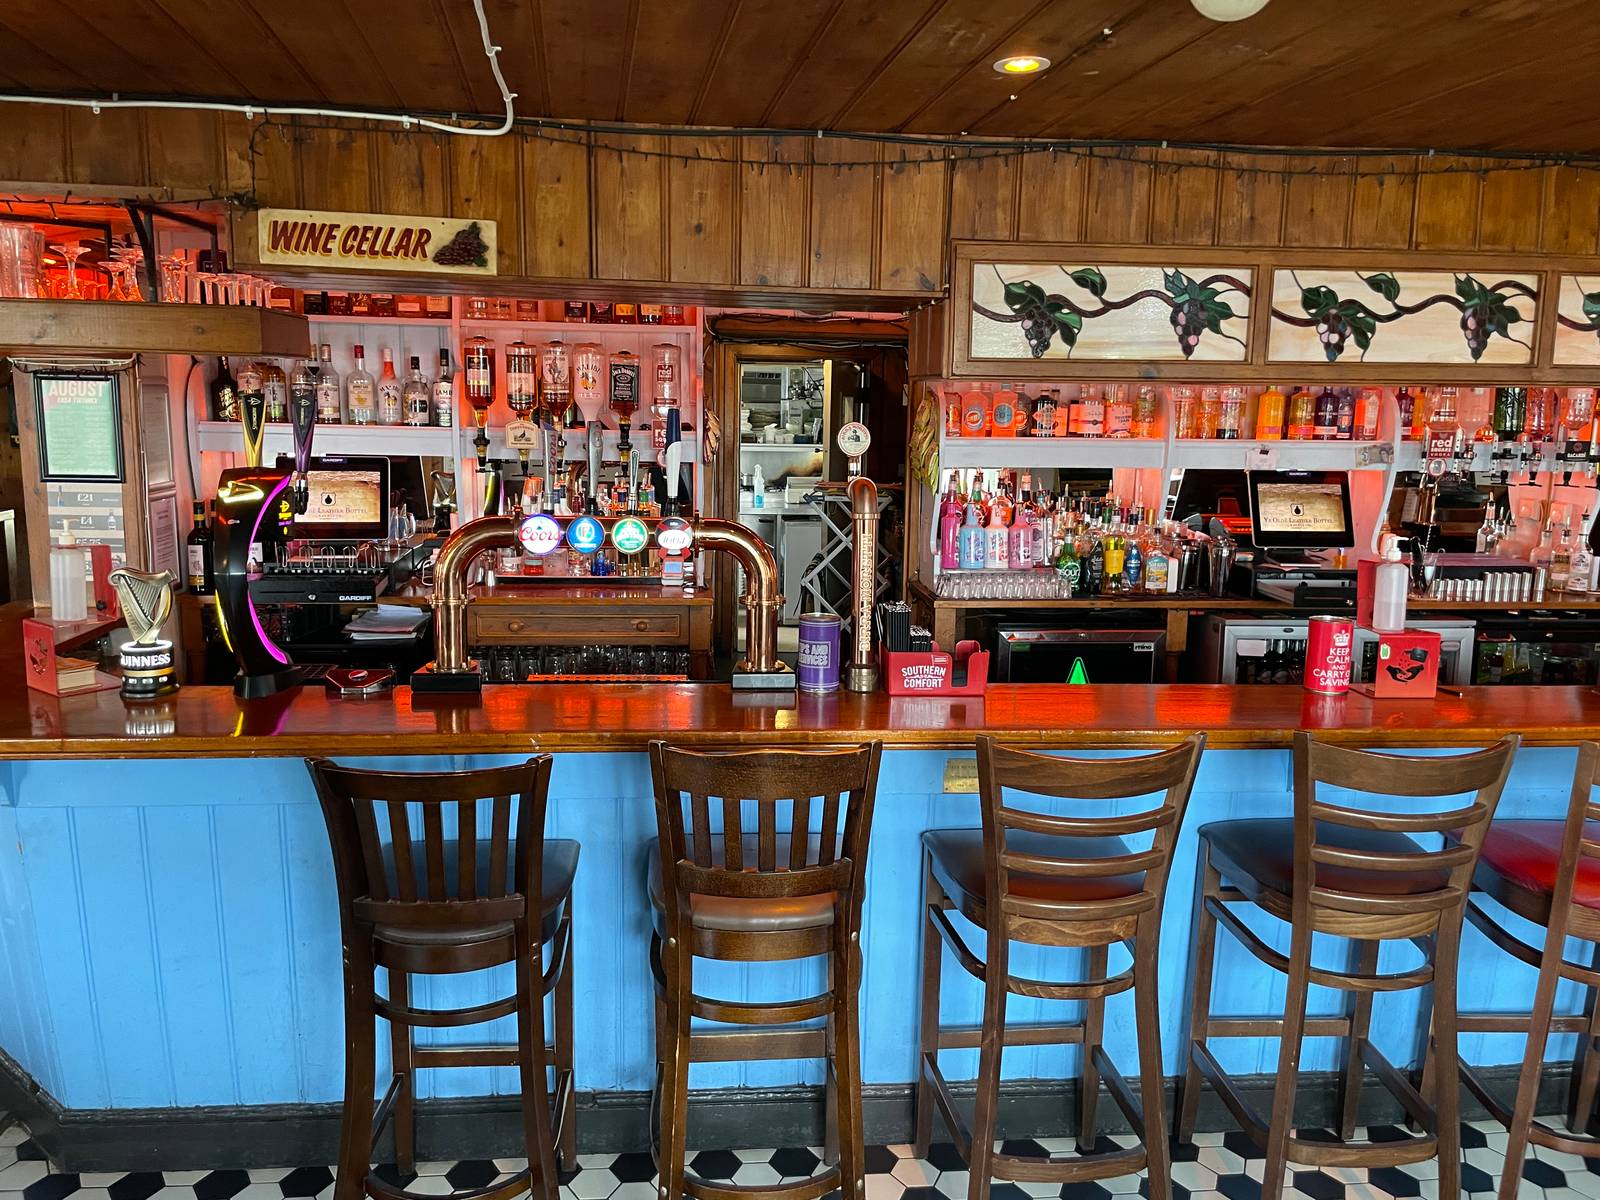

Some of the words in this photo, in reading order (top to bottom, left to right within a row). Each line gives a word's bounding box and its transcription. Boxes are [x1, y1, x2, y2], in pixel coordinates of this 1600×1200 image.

[268, 219, 341, 256] WINE
[340, 224, 432, 261] CELLAR
[48, 381, 104, 398] AUGUST
[1431, 435, 1454, 448] red
[77, 493, 94, 502] £21
[80, 516, 93, 525] £4
[518, 526, 562, 543] Coors
[861, 533, 873, 602] MORETTI
[859, 604, 872, 652] BIRRA
[811, 644, 829, 655] AND
[1329, 647, 1350, 656] KEEP
[901, 665, 946, 678] SOUTHERN
[1312, 668, 1344, 678] CARRY
[903, 678, 944, 688] COMFORT
